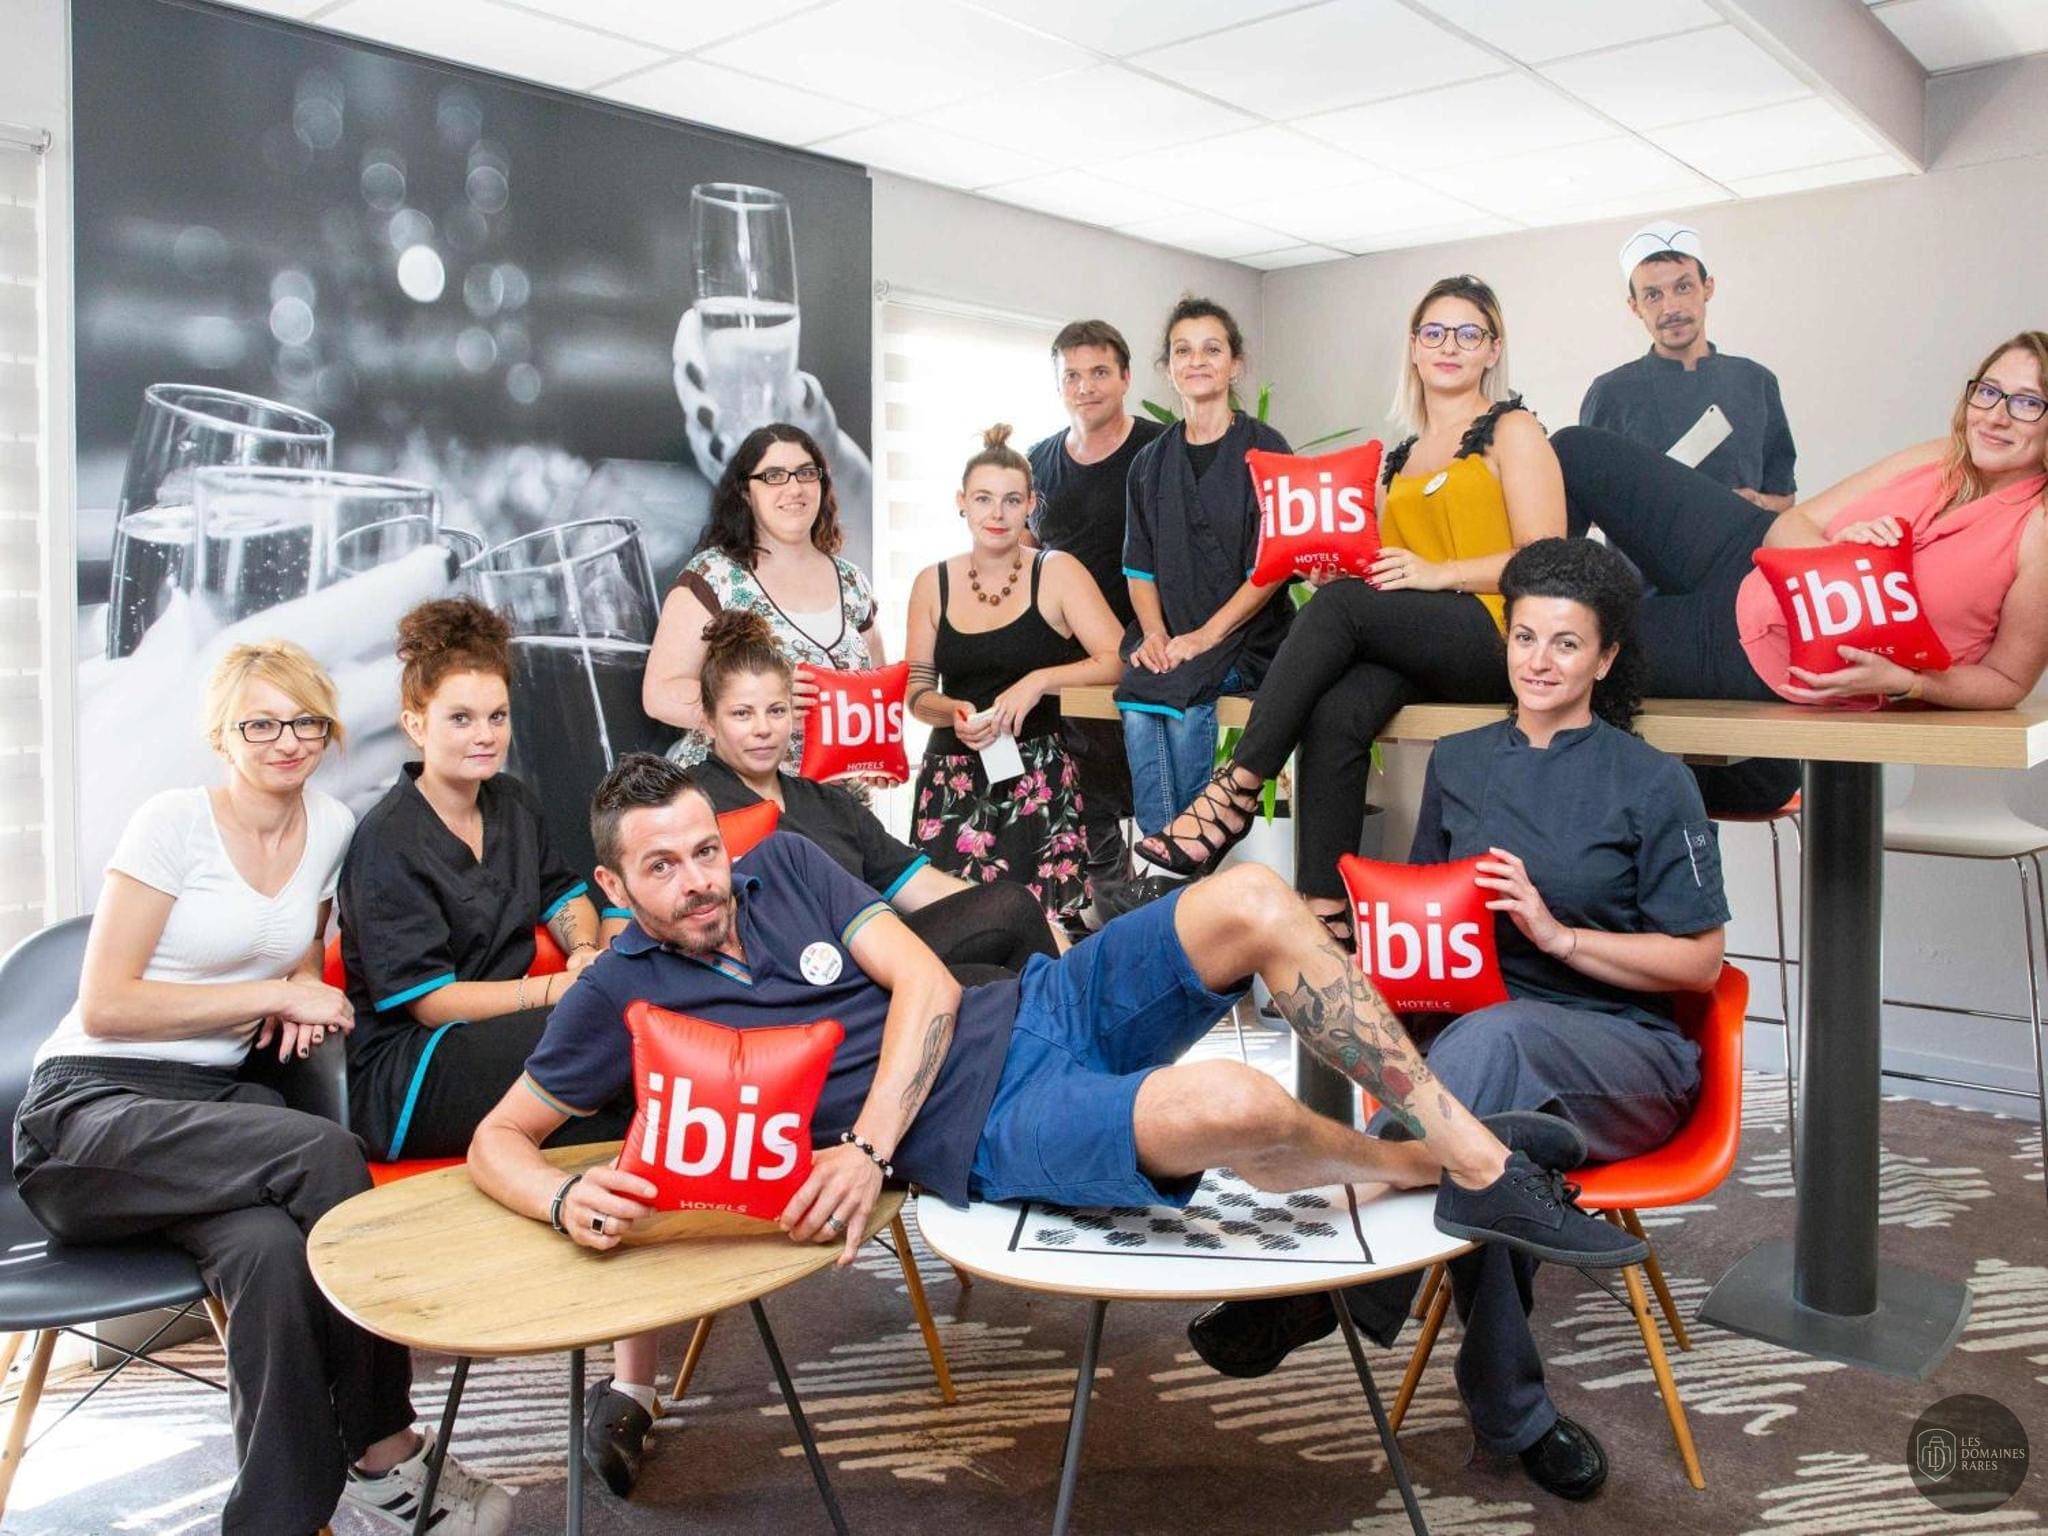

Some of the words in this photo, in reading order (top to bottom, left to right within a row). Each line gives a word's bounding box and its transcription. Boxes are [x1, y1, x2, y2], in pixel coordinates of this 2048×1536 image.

[1263, 471, 1366, 538] ibis
[1295, 553, 1340, 564] HOTELS
[1785, 558, 1919, 642] ibis
[819, 688, 902, 746] ibis
[847, 761, 885, 771] HOTELS
[1358, 901, 1483, 980] ibis
[640, 1072, 801, 1181] ibis
[680, 1200, 748, 1213] HOTELS
